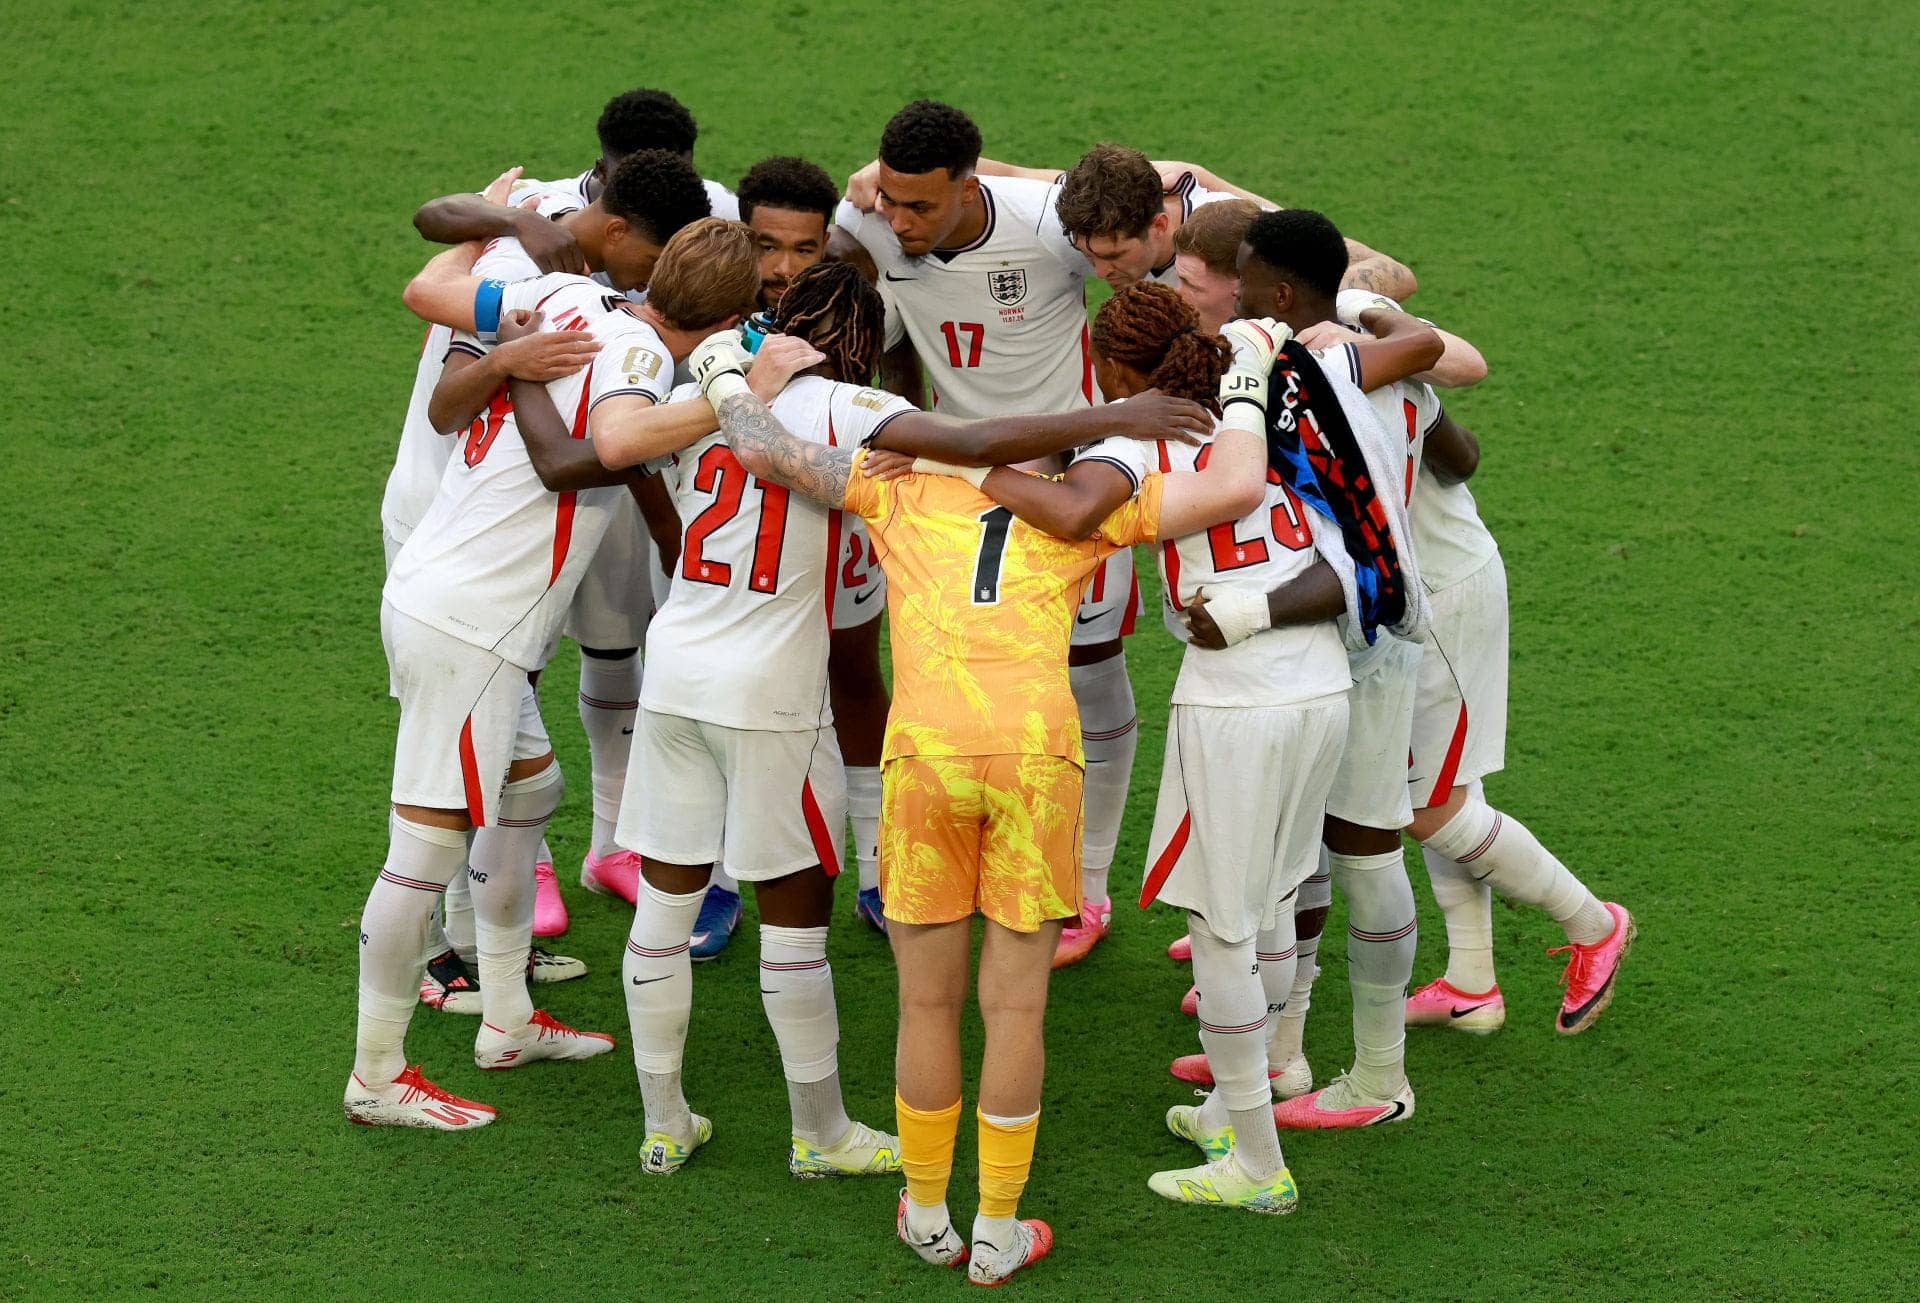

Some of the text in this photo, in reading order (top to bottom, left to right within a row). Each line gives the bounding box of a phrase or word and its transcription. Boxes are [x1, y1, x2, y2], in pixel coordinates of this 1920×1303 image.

[940, 321, 985, 368] 17
[697, 355, 716, 385] JP
[1228, 375, 1260, 391] JP
[682, 443, 791, 595] 21
[971, 505, 1016, 606] 1
